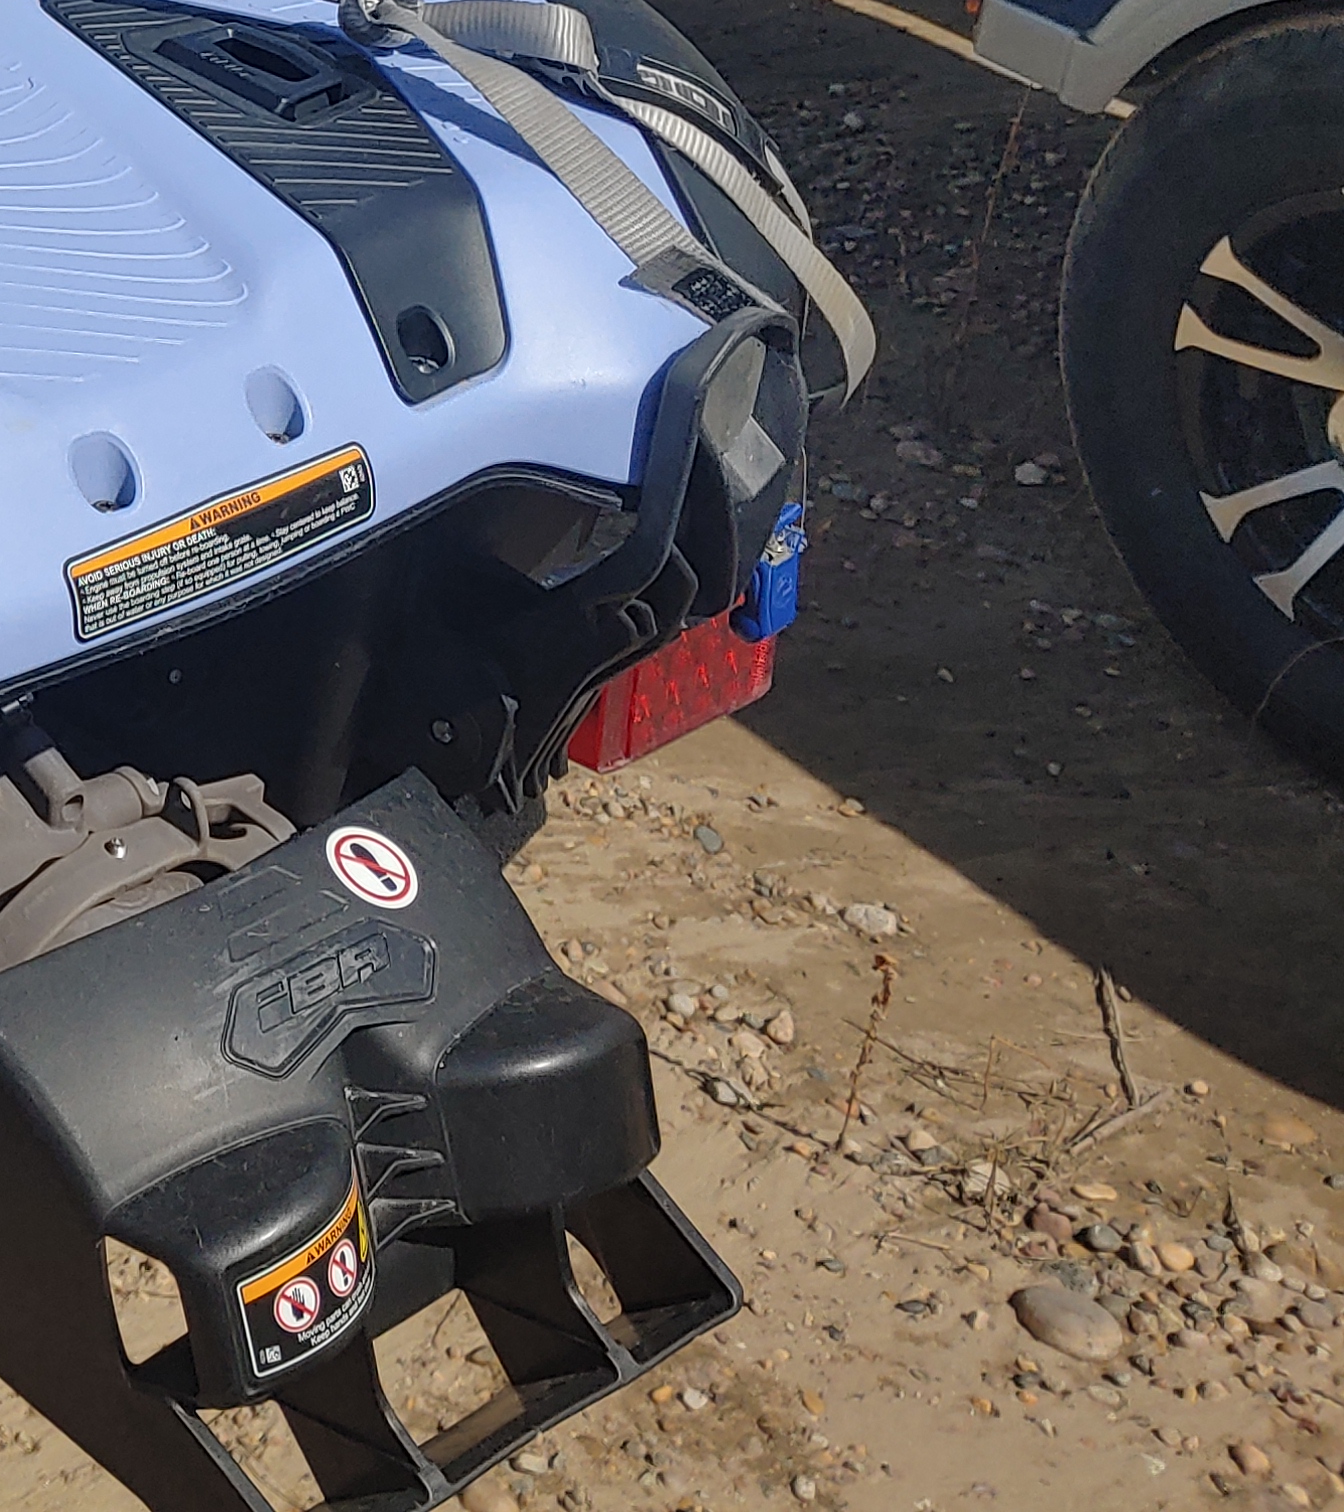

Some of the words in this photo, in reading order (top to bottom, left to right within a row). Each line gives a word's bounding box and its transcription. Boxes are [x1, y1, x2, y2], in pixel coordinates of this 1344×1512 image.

[199, 491, 262, 527] WARNING
[78, 569, 101, 587] AVOID
[104, 555, 139, 577] SERIOUS
[142, 543, 170, 563] INJURY
[172, 537, 184, 551] OR
